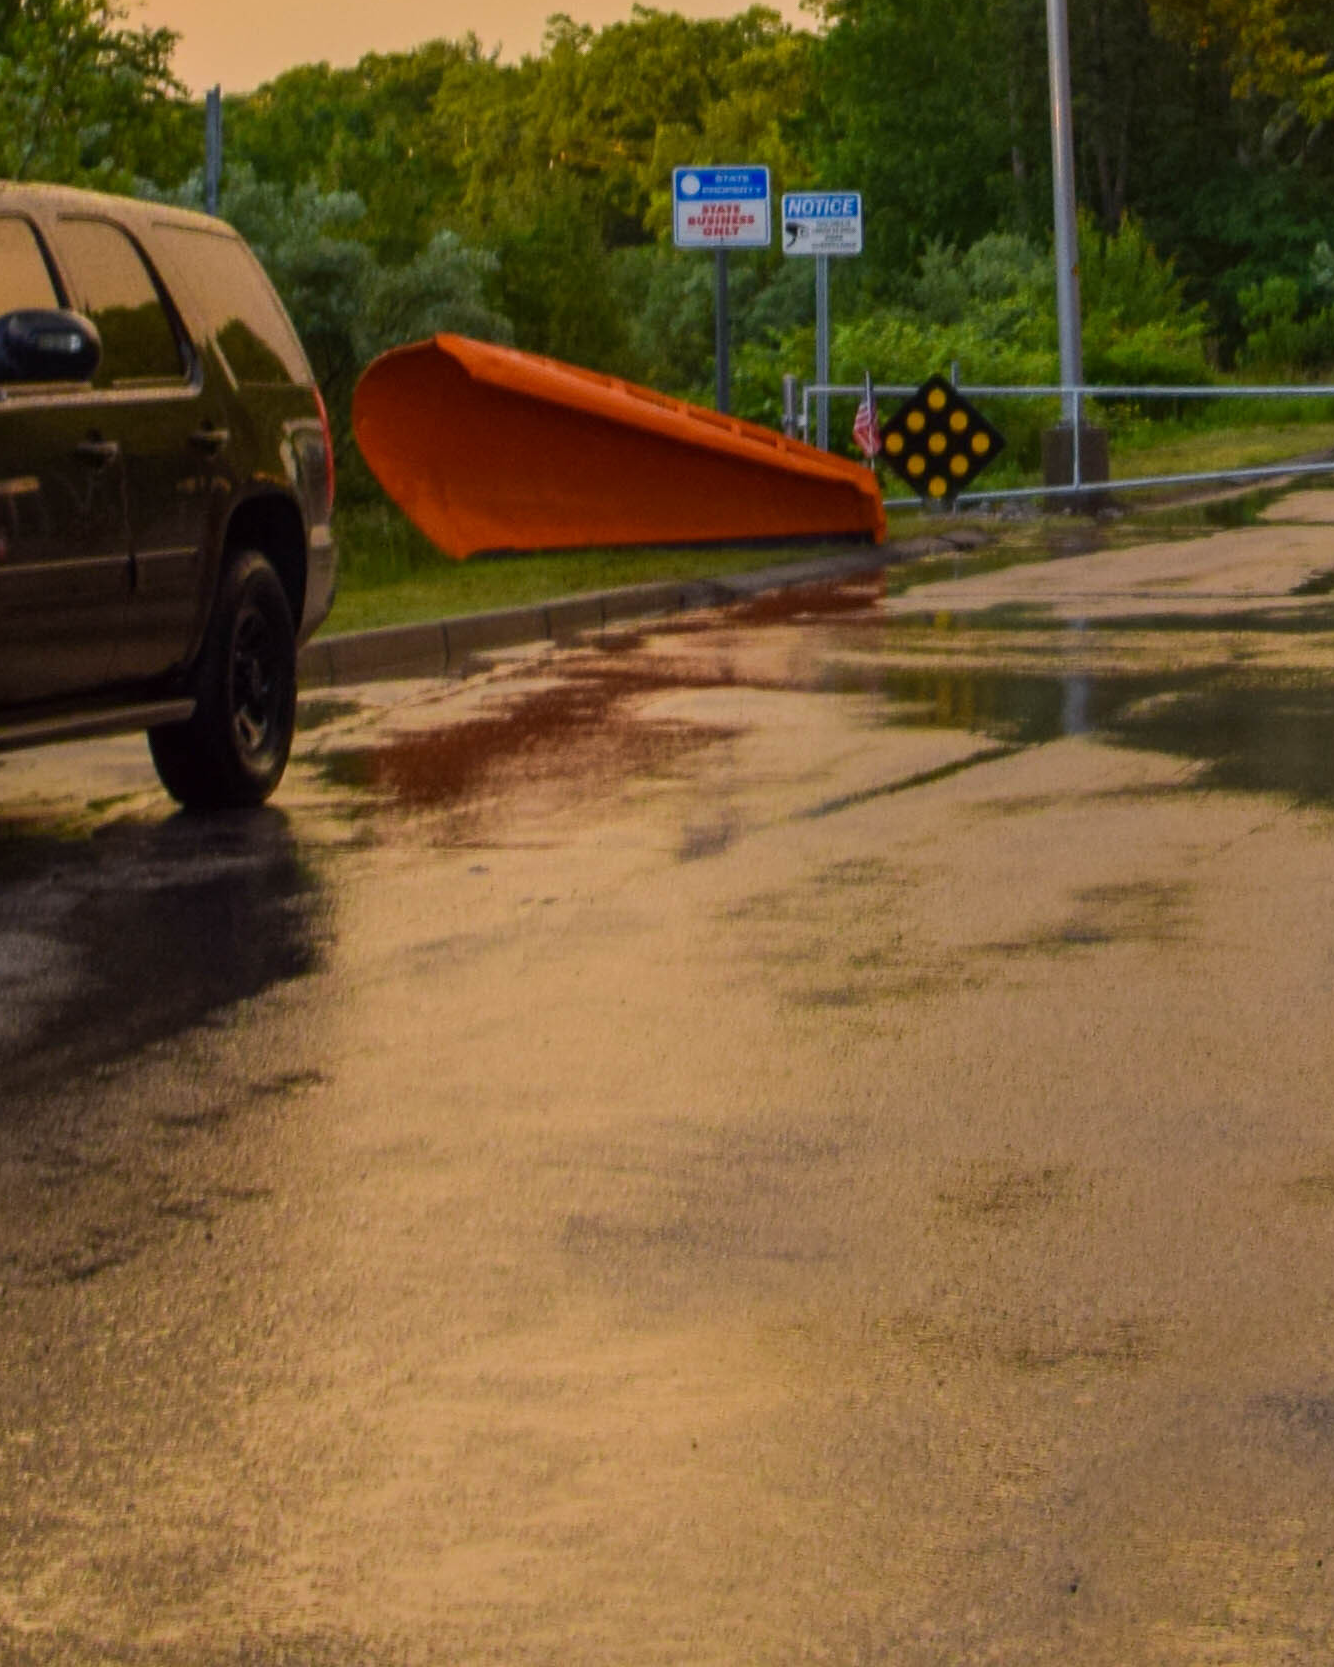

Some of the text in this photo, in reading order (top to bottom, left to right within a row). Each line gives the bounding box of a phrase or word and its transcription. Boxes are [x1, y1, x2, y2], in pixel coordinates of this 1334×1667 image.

[715, 175, 749, 183] STATE
[702, 204, 740, 213] STATE
[788, 198, 853, 216] NOTICE
[687, 215, 755, 226] BUSINESS
[703, 227, 739, 236] ONLY
